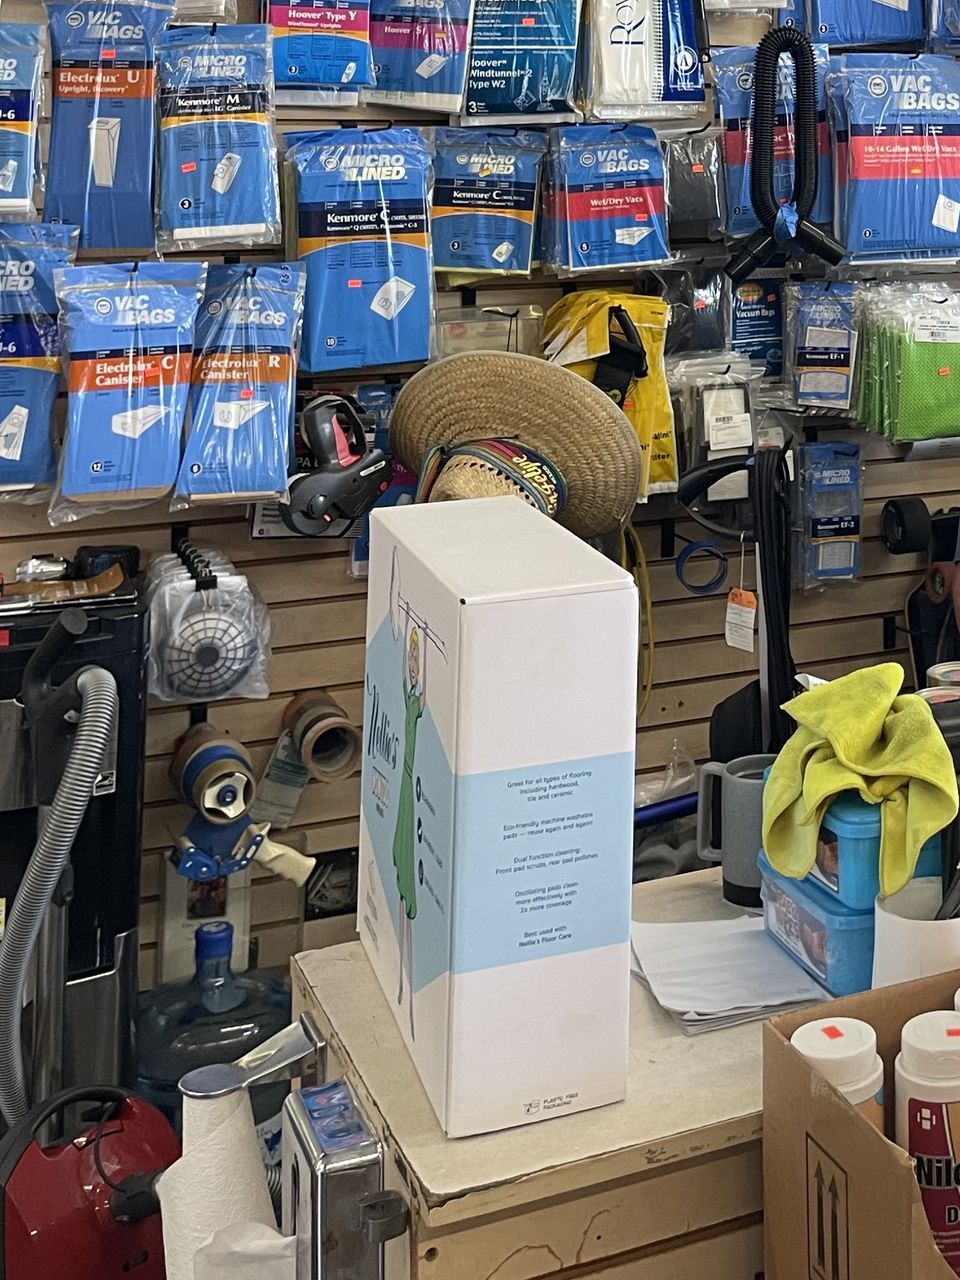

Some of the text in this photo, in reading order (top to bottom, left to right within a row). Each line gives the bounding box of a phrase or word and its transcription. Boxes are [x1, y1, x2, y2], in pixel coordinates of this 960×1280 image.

[87, 11, 122, 25] VAC
[288, 11, 347, 23] Hoover Type
[384, 26, 411, 34] Hoover
[195, 55, 247, 66] MICRO
[127, 70, 140, 83] U
[201, 66, 246, 77] LINED
[891, 74, 932, 93] VAC
[178, 93, 240, 107] Kenmore M
[903, 92, 960, 111] BAGS
[343, 154, 405, 168] MICRO
[470, 153, 516, 164] MICRO
[597, 149, 629, 162] VAC
[606, 159, 650, 173] BAGS
[453, 190, 491, 199] Kenmore
[590, 195, 644, 207] Wet/Dry Vacs
[327, 212, 376, 224] Kenmore
[114, 295, 150, 311] VAC
[226, 296, 262, 311] VAC
[238, 309, 287, 326] BAGS
[162, 355, 174, 370] C
[268, 355, 281, 368] R
[830, 351, 844, 360] EF-1
[200, 368, 249, 380] Canister
[507, 780, 523, 788] Great
[543, 775, 560, 784] types
[568, 770, 592, 780] flooring
[503, 812, 594, 831] Eco-friendly machine washable
[495, 852, 599, 875] Front pad scrubs, rear pad polishes
[513, 855, 527, 863] Dual
[529, 851, 554, 861] function
[514, 881, 579, 897] Oscillating pads clean
[515, 889, 578, 906] more effectively with
[520, 899, 573, 914] 2x more coverage
